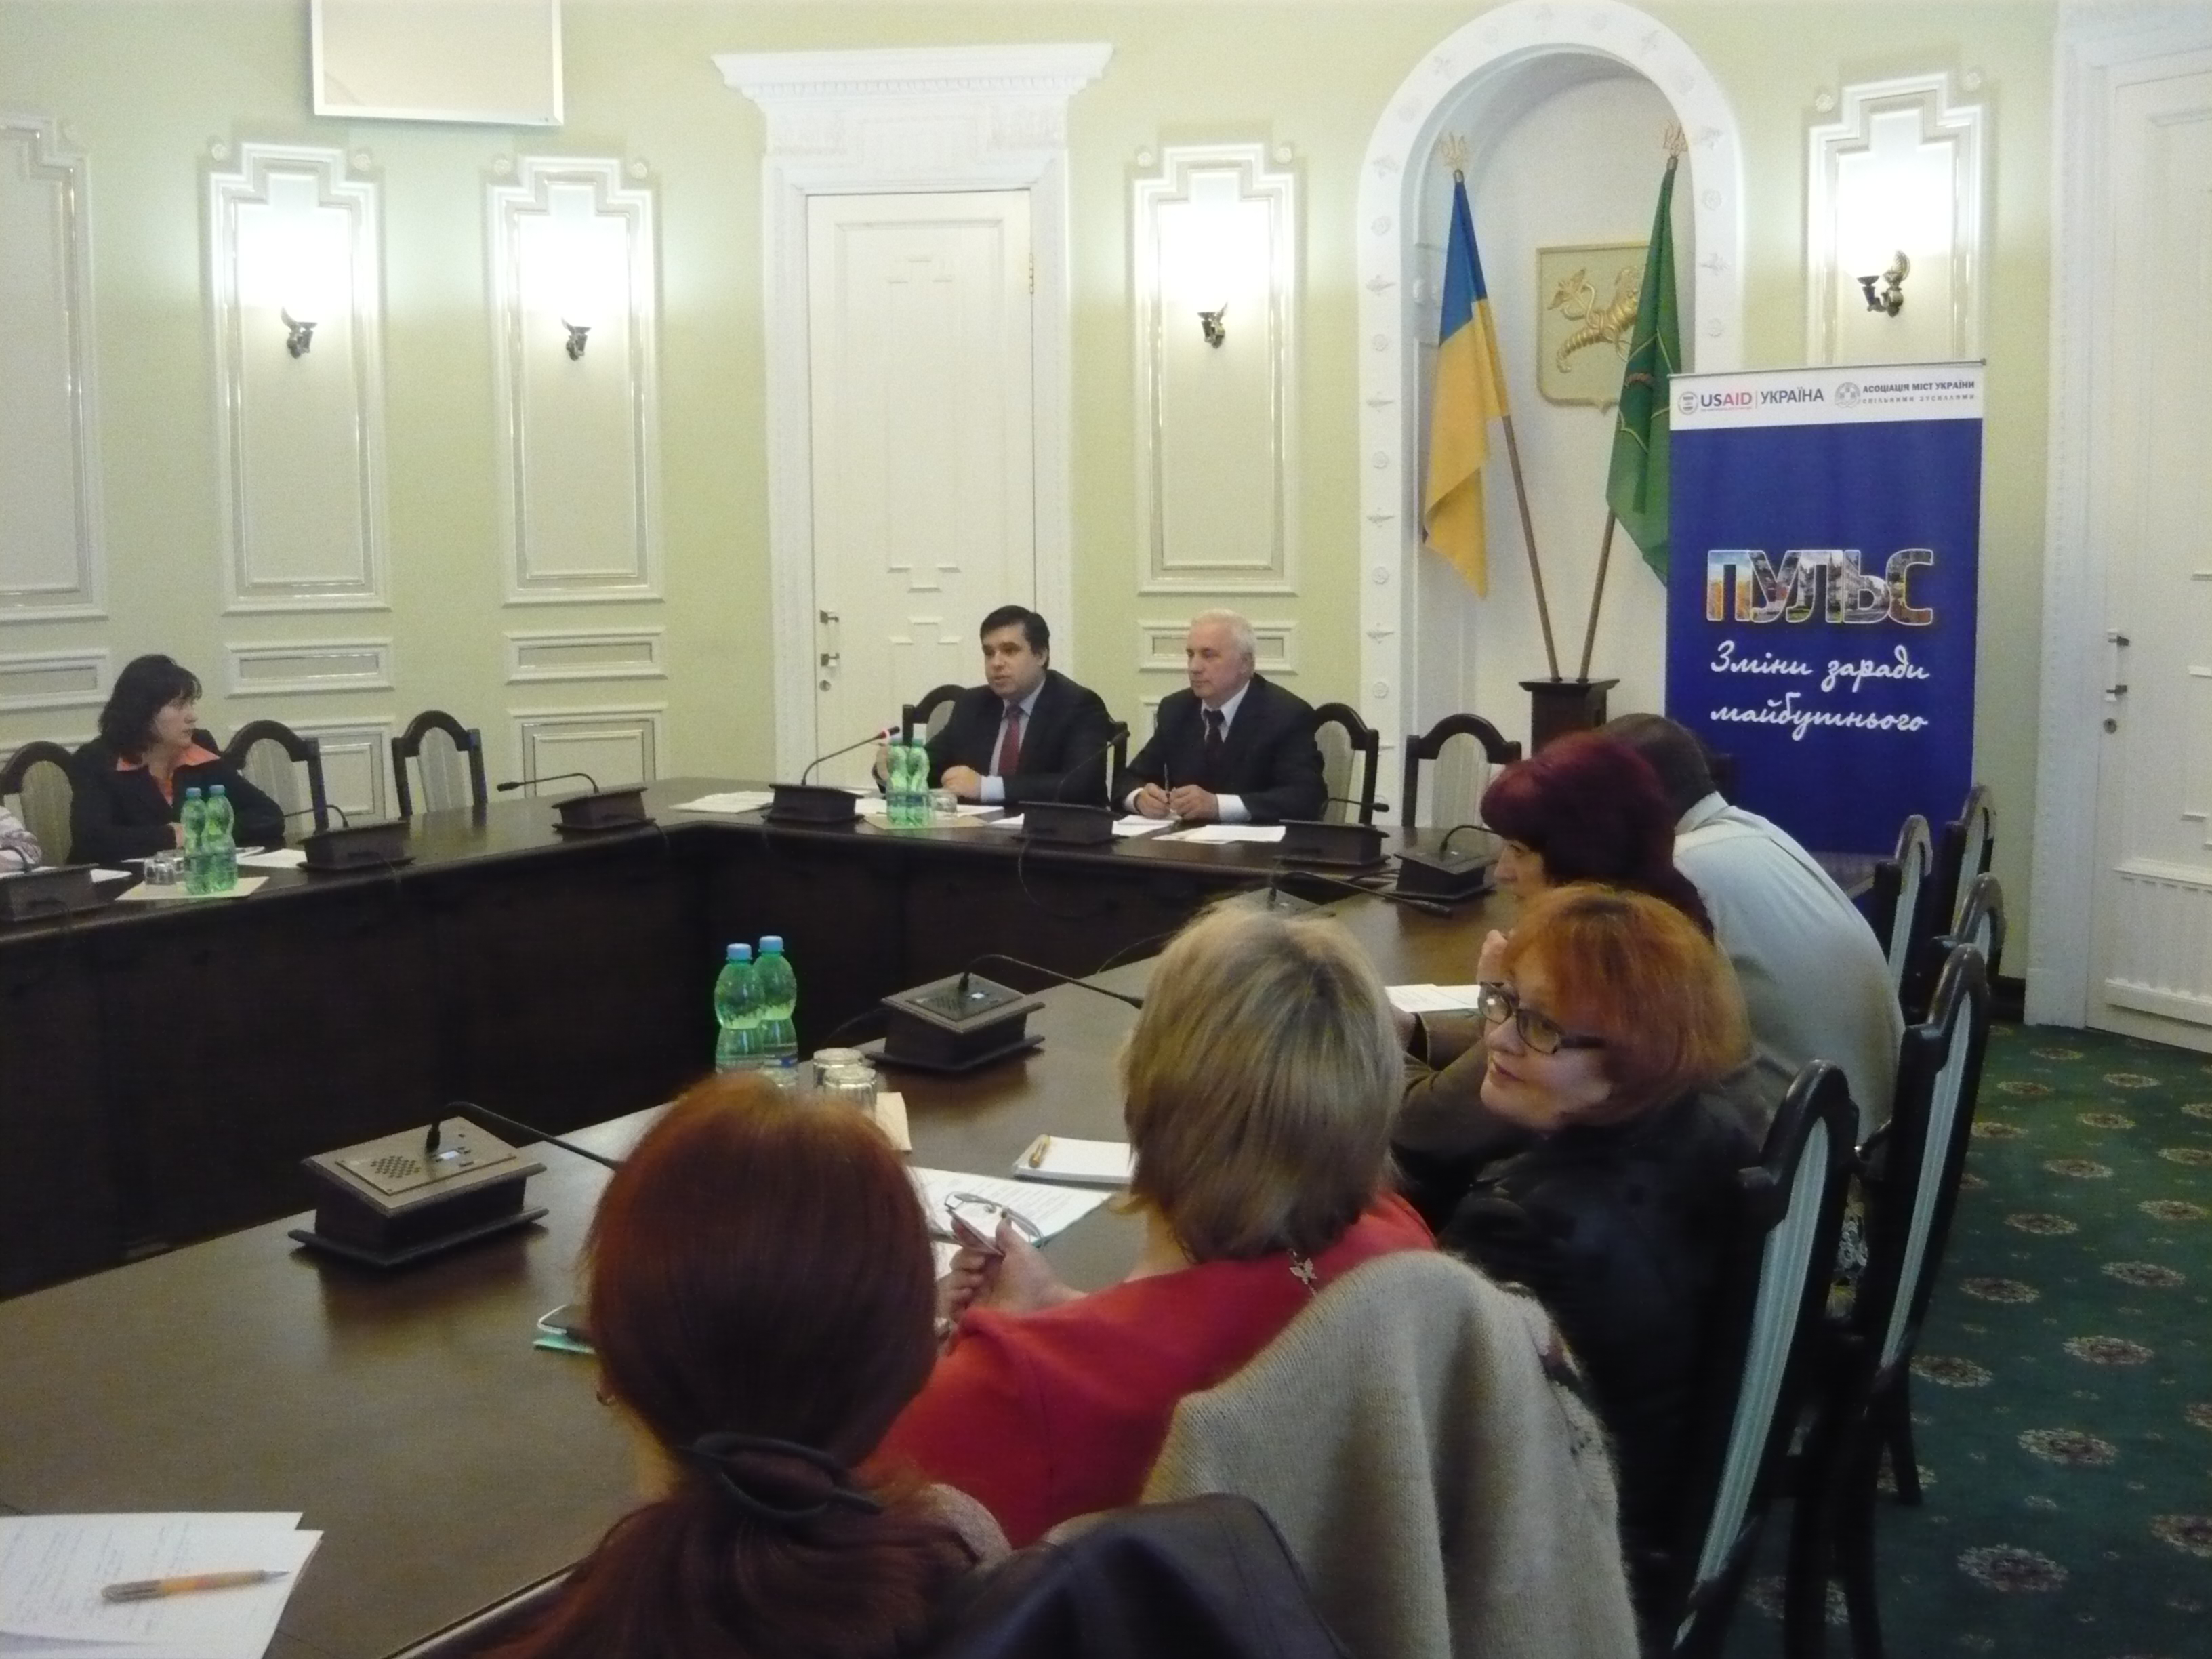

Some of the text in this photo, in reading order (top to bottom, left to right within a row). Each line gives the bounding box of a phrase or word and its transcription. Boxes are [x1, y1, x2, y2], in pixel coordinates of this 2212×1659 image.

[1700, 392, 1753, 407] USAID
[1760, 386, 1824, 405] УКРАЇНА
[1862, 380, 1975, 393] АСОЦІАЦІЯ МІСТ УКРАЇНИ
[1706, 548, 1934, 626] ПУЛЬС
[1710, 640, 1930, 693] Зміни заради
[1710, 692, 1929, 741] майбутнього
